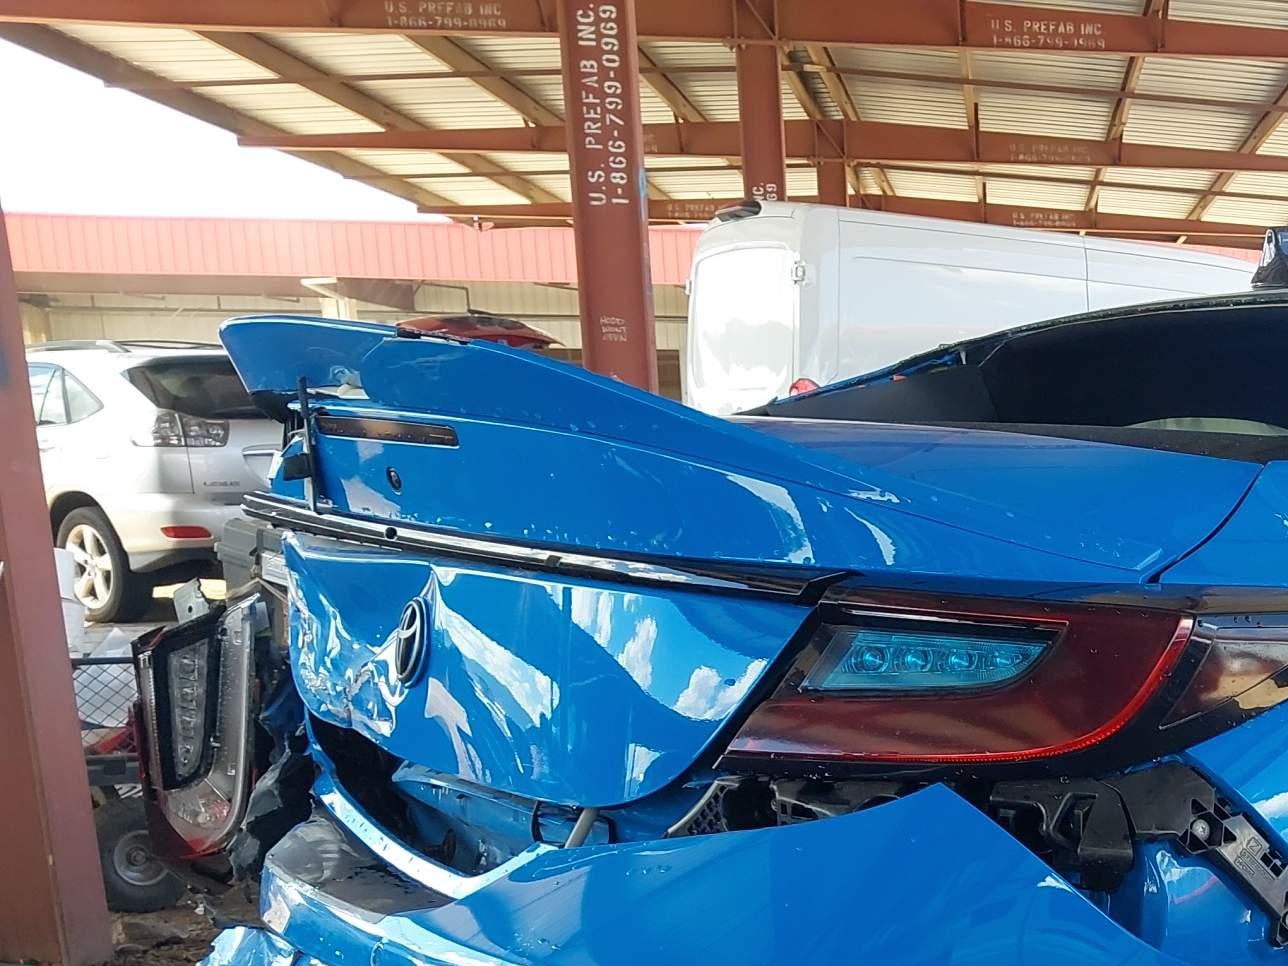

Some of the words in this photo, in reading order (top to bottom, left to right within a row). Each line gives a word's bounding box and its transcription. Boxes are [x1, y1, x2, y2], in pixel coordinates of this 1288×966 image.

[576, 3, 597, 46] INC.
[1023, 19, 1074, 34] PREFAB
[580, 59, 604, 149] PREFAB
[598, 4, 630, 205] 1-866-799-0969
[587, 163, 607, 206] U.S.
